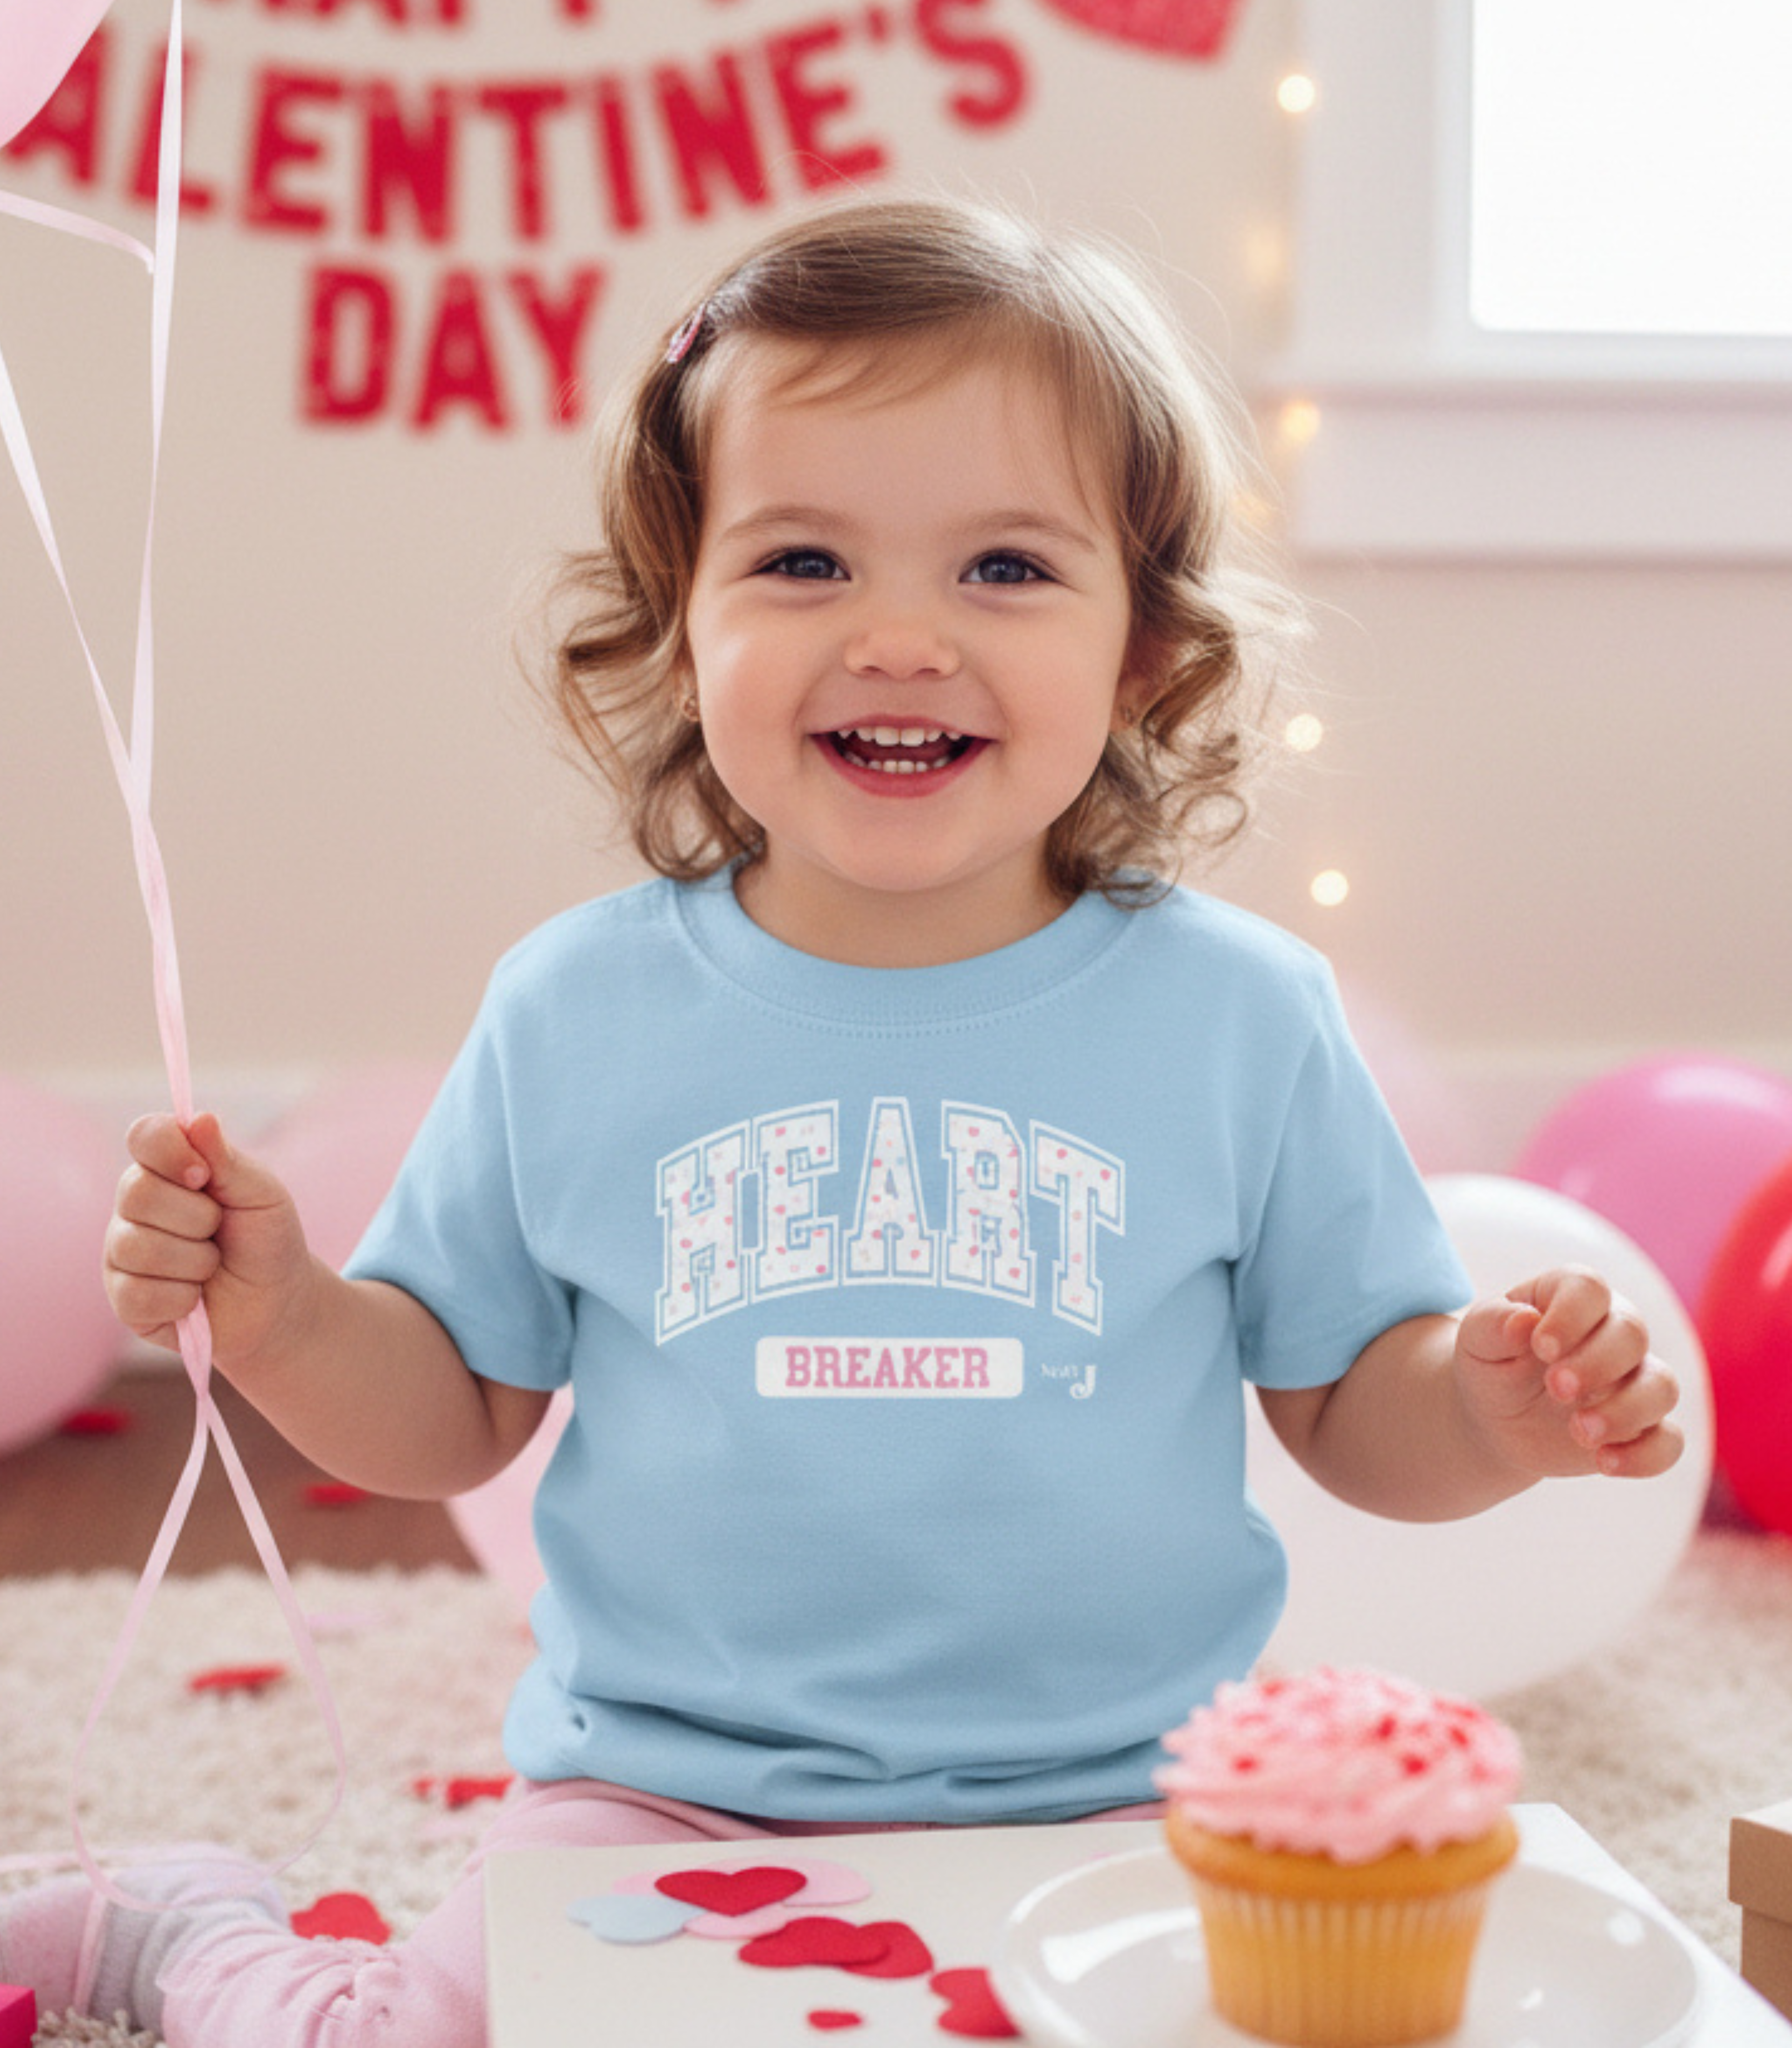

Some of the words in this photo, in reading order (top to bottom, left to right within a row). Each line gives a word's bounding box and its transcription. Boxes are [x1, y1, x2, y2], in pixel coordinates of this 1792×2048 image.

[1, 0, 1033, 245] ALENTINE'S
[300, 260, 605, 433] DAY
[655, 1096, 1126, 1346] HEART
[785, 1345, 990, 1389] BREAKER
